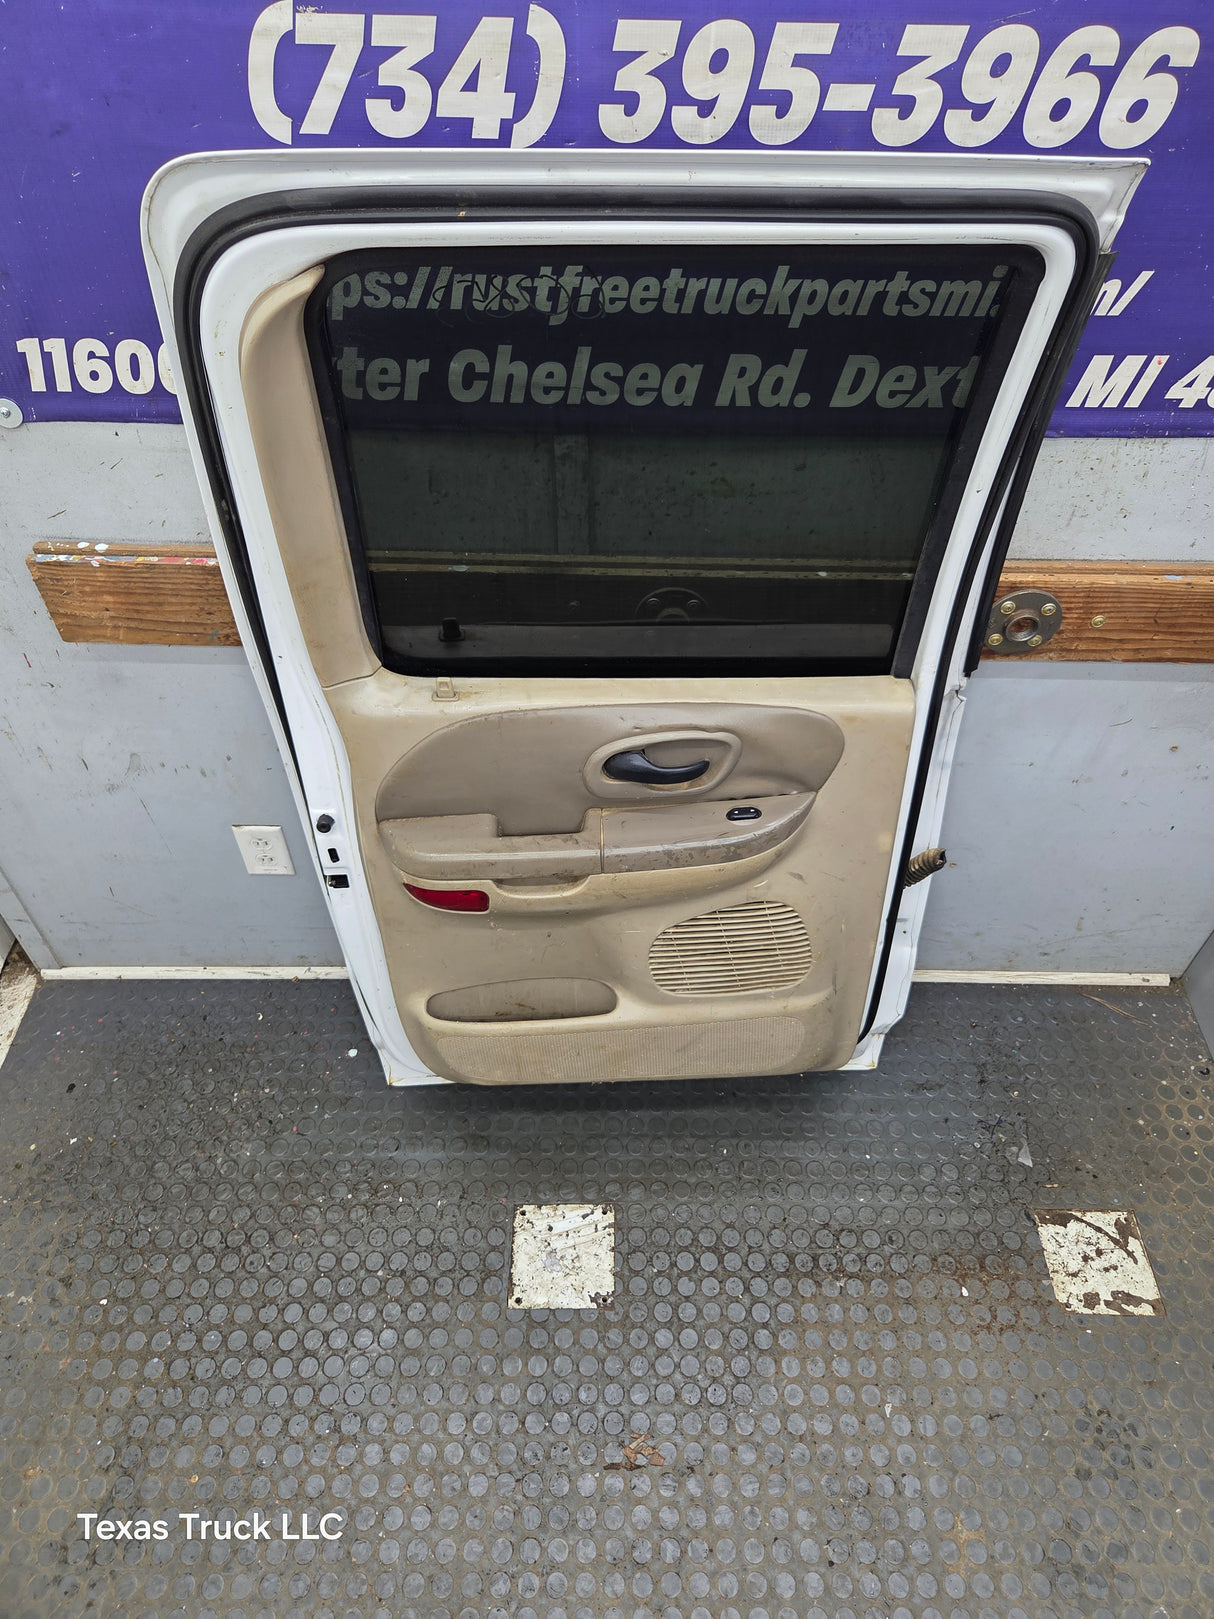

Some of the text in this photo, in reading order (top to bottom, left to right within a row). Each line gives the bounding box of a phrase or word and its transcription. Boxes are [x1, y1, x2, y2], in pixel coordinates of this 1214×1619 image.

[248, 0, 1200, 149] (734) 395-3966
[332, 347, 430, 401] ter
[448, 345, 702, 408] Chelsea
[714, 349, 811, 408] Rd.
[1065, 354, 1170, 408] MI
[1163, 354, 1214, 408] 4
